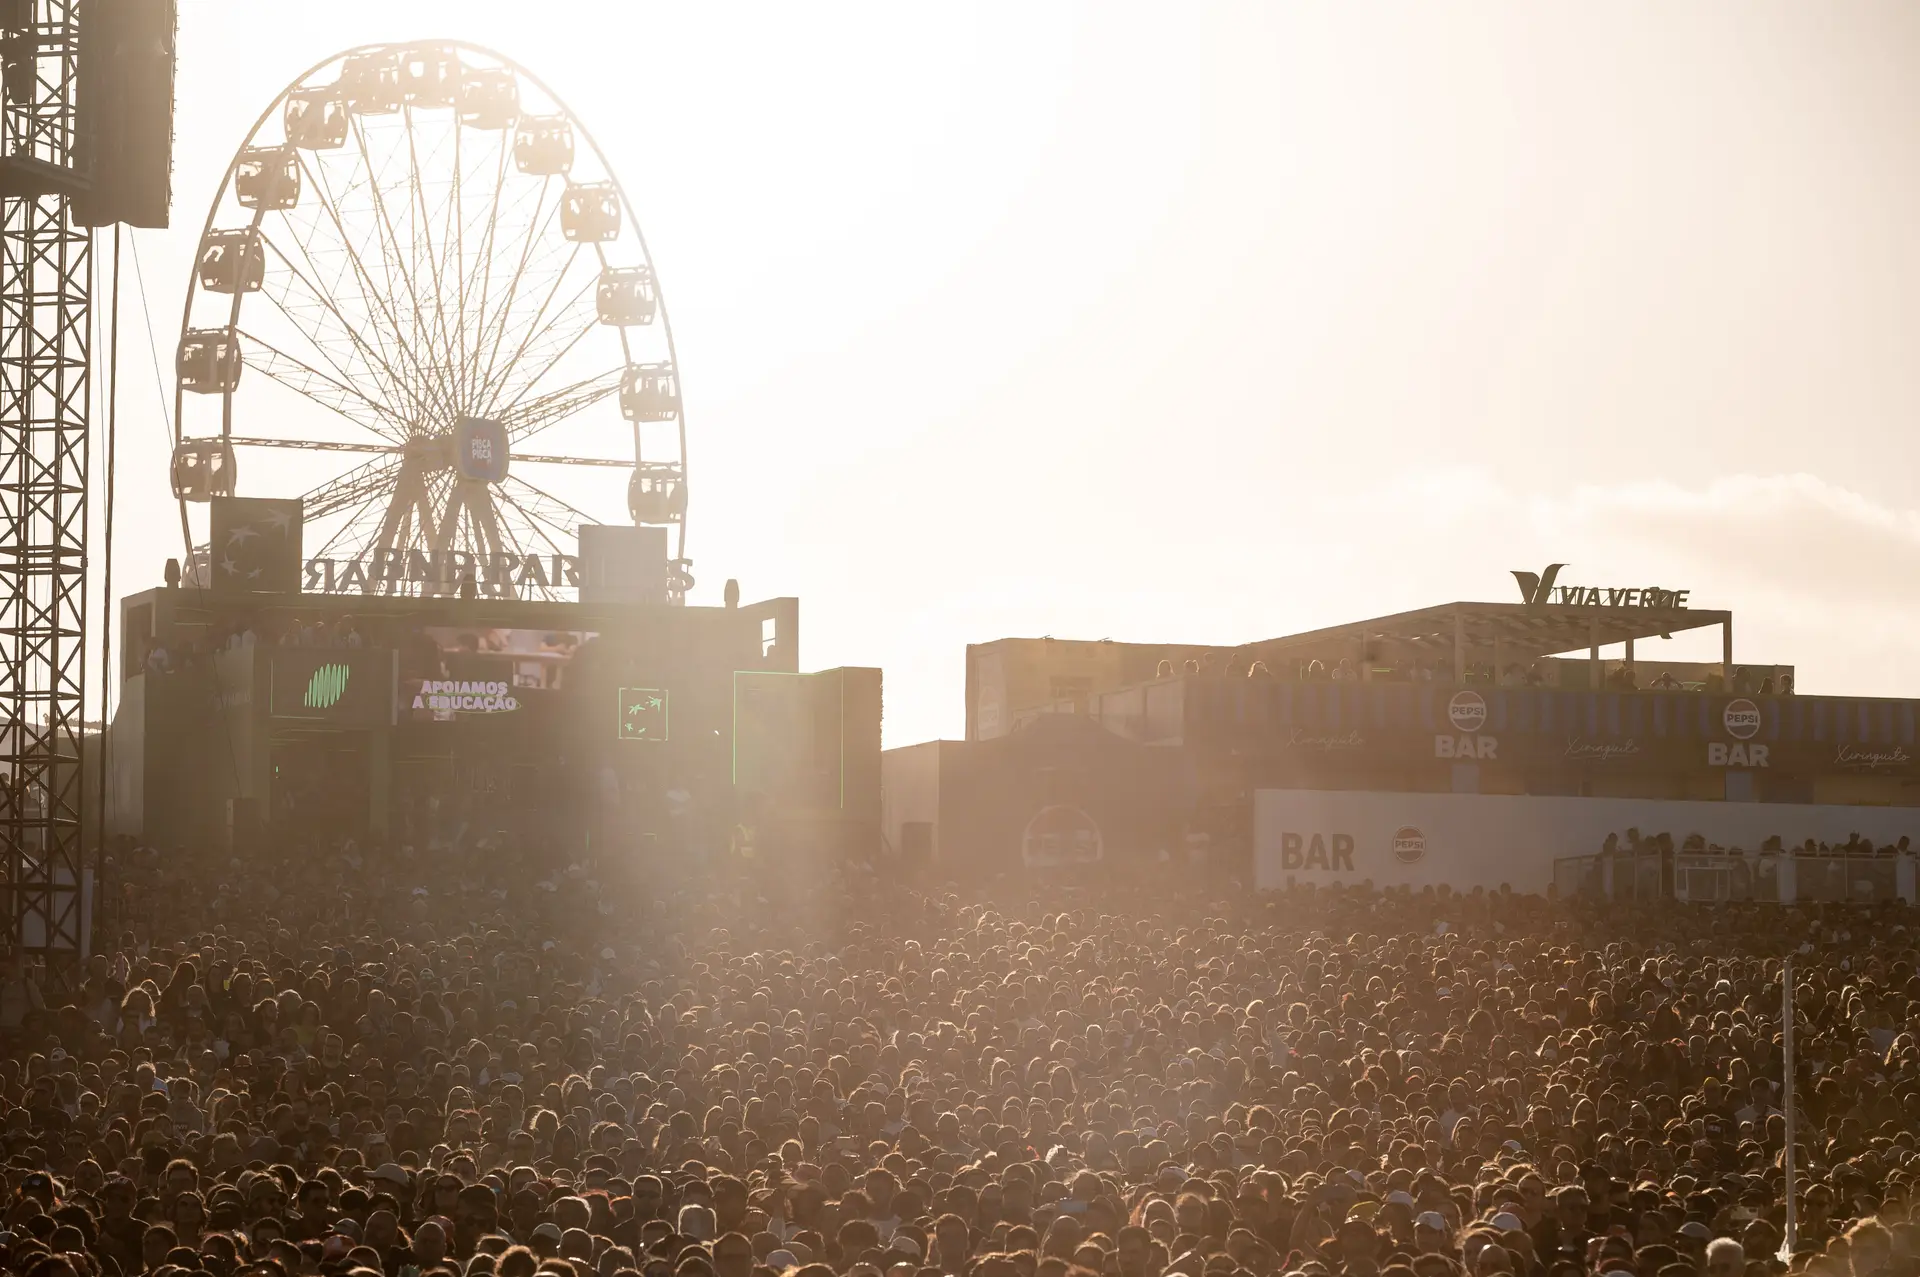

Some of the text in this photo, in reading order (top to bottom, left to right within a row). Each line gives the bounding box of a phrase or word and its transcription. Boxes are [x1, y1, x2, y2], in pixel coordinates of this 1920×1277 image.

[1561, 586, 1690, 610] VIA VERDE
[421, 680, 508, 695] APOIAMOS
[412, 693, 516, 712] A EDUCAÇÃO
[1451, 705, 1484, 717] PEPSI
[1726, 713, 1759, 724] PEPSI
[1434, 734, 1499, 760] BAR
[1708, 742, 1770, 767] BAR
[1281, 831, 1355, 871] BAR
[1395, 839, 1424, 850] PEPSI
